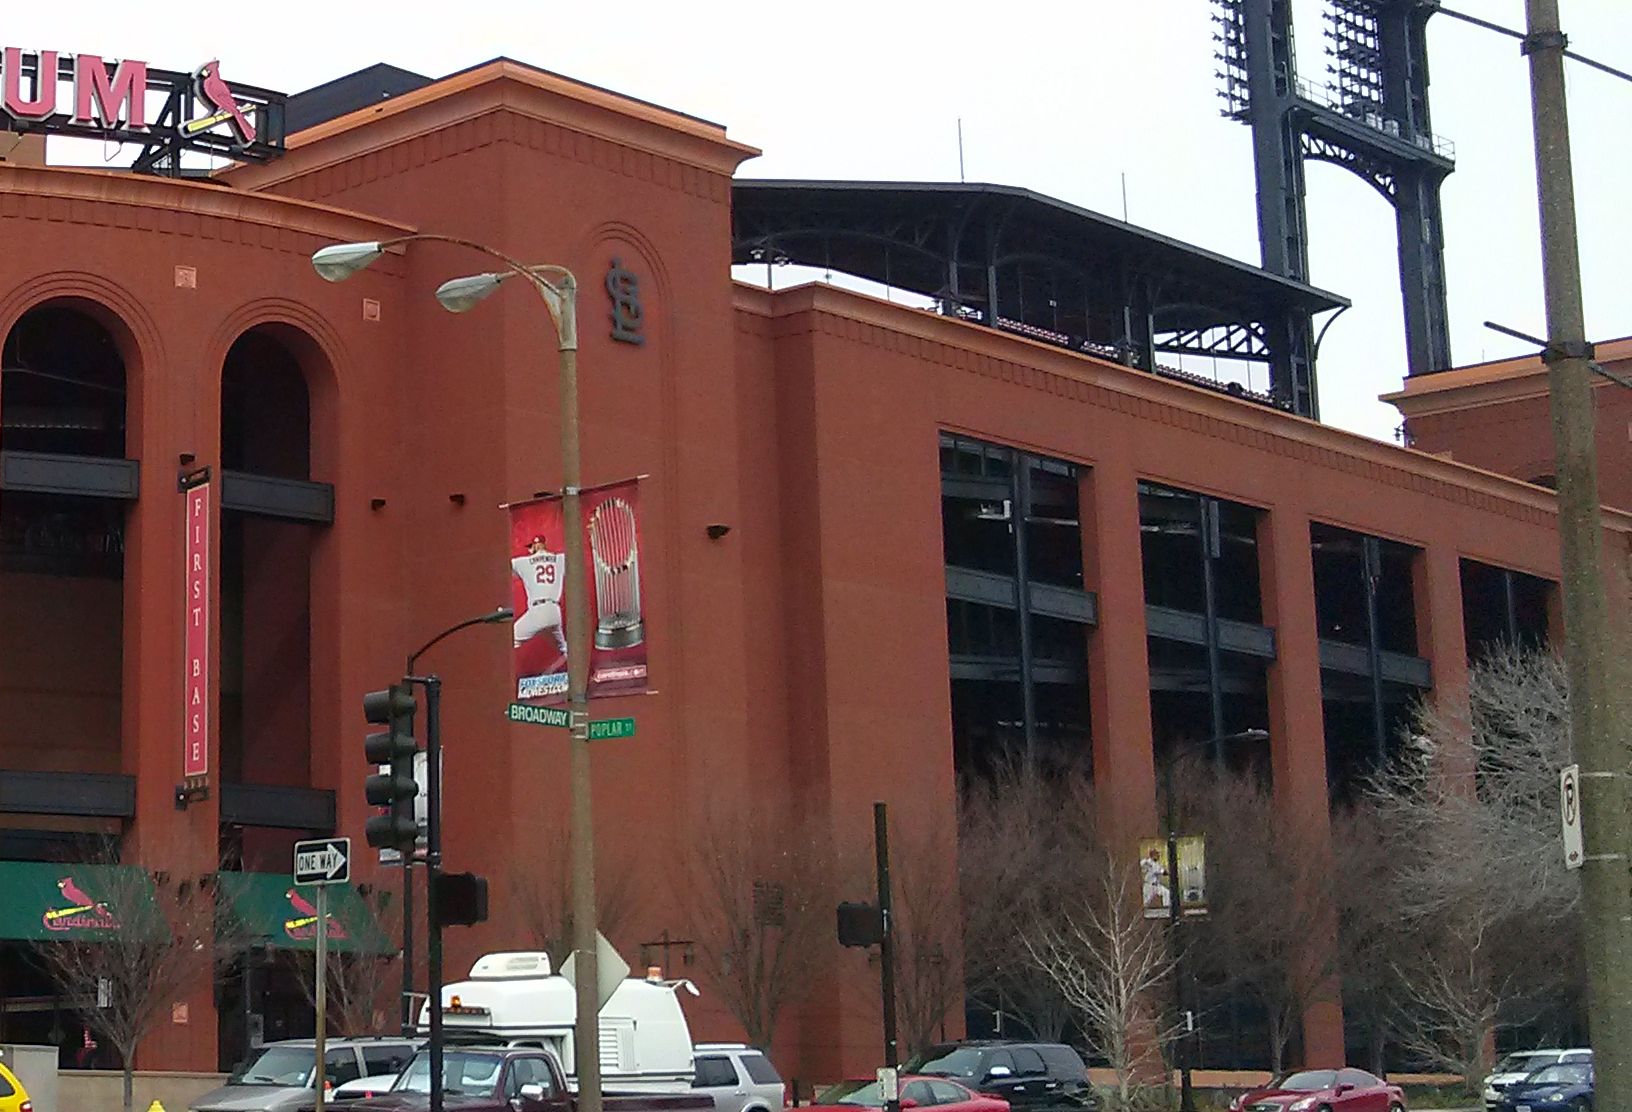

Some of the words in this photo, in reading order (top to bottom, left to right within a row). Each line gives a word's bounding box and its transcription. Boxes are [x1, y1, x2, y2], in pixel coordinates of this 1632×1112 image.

[192, 498, 202, 627] FIRST
[535, 564, 556, 585] 29
[191, 659, 201, 762] BASE
[510, 704, 568, 727] BROADWAY
[591, 722, 623, 737] POPLAR
[298, 854, 317, 872] ONE
[319, 852, 338, 870] WAY
